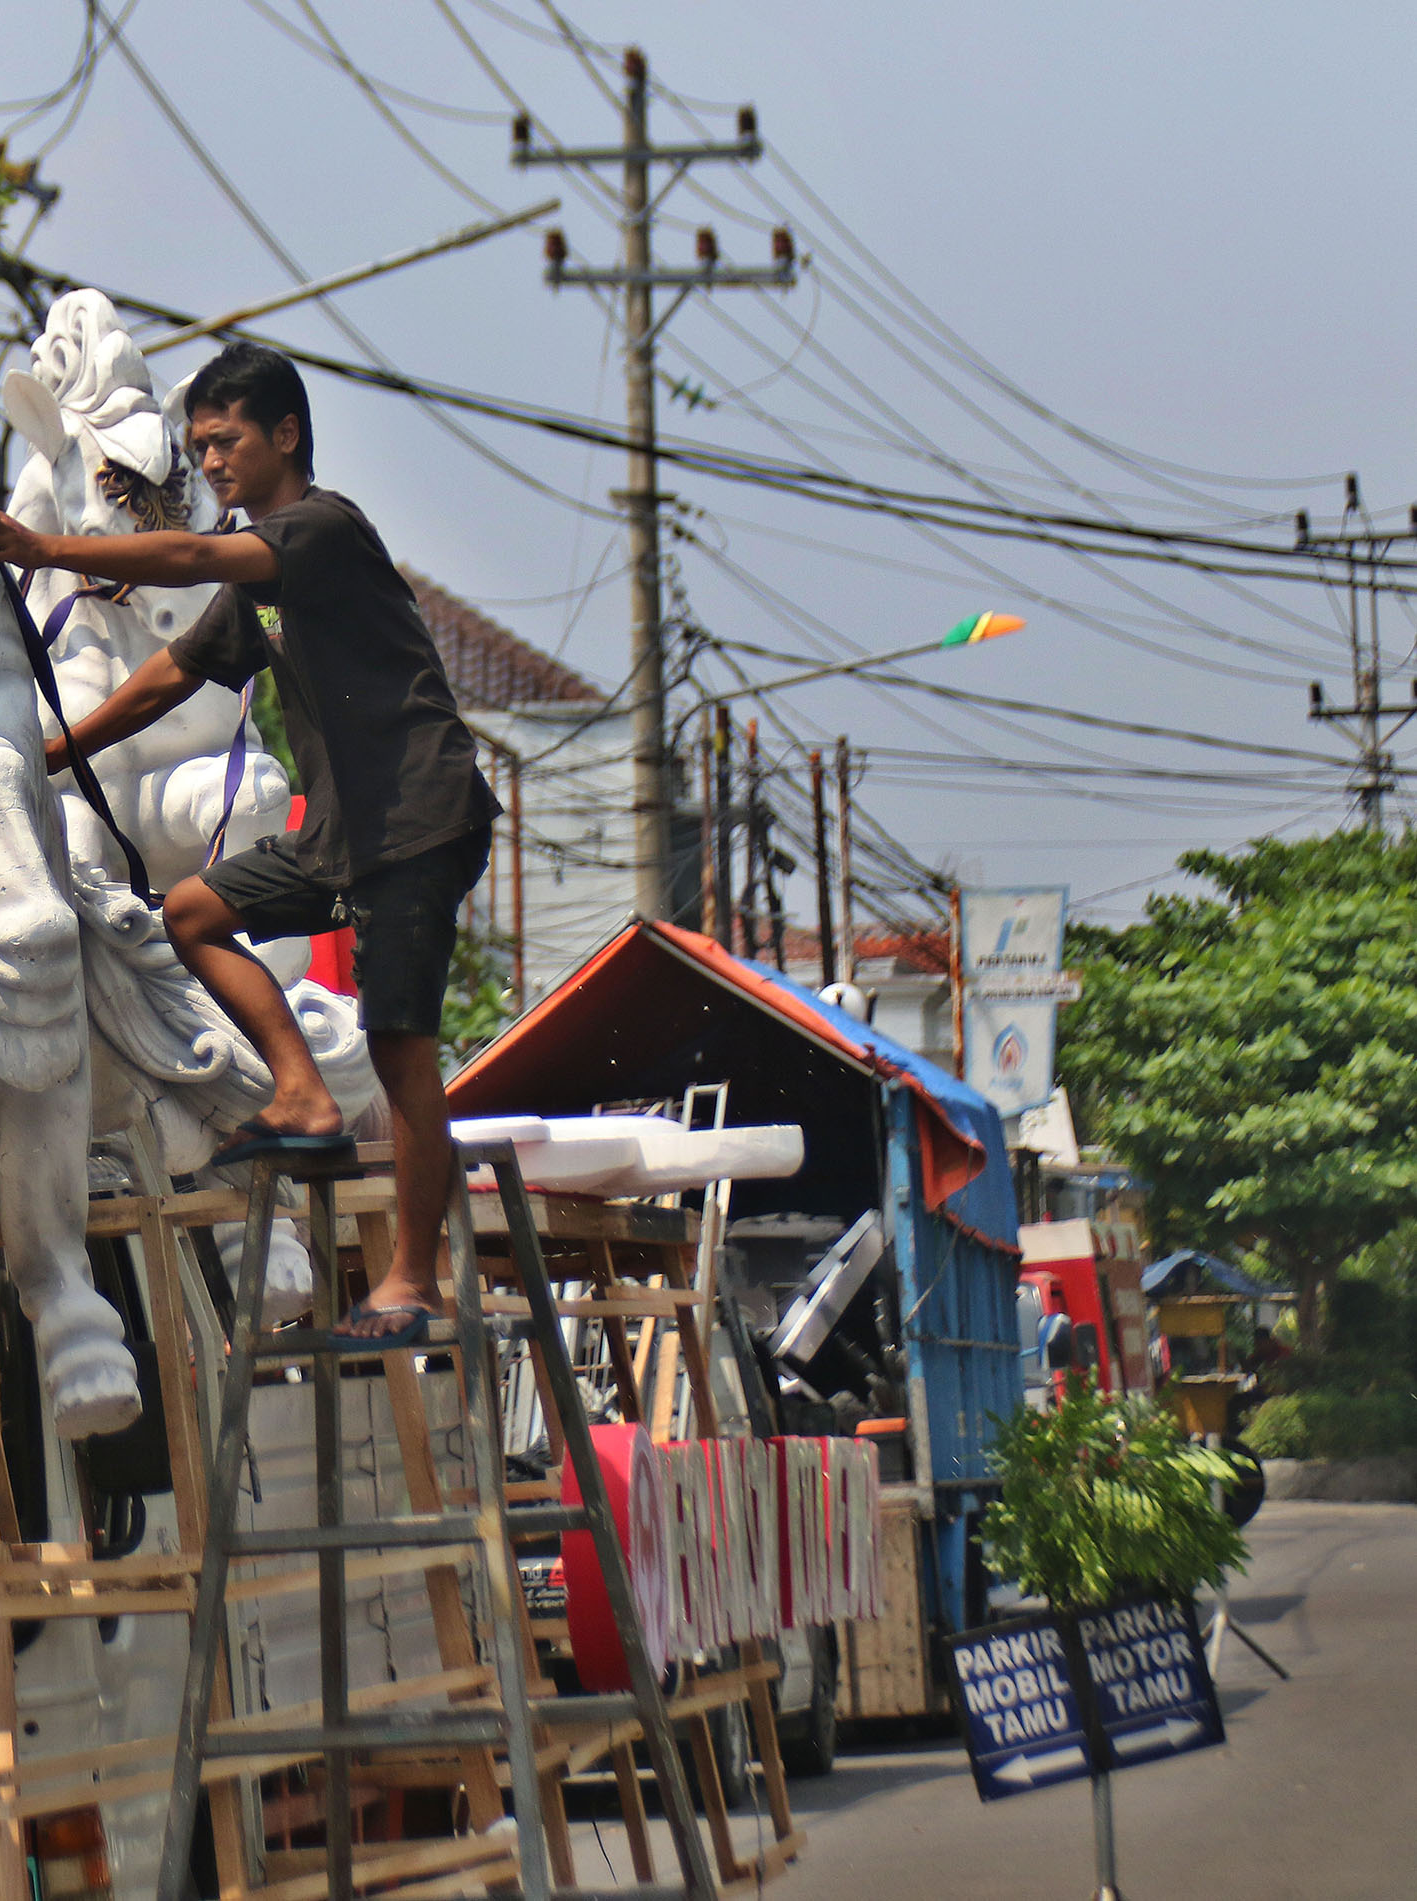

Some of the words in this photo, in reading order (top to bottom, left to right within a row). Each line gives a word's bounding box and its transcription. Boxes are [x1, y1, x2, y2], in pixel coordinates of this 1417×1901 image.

[1078, 1602, 1188, 1651] PARKIR
[954, 1627, 1066, 1680] PARKIR
[1087, 1631, 1195, 1686] MOTOR
[964, 1666, 1072, 1716] MOBIL
[1108, 1669, 1192, 1715] TAMU
[983, 1700, 1070, 1747] TAMU
